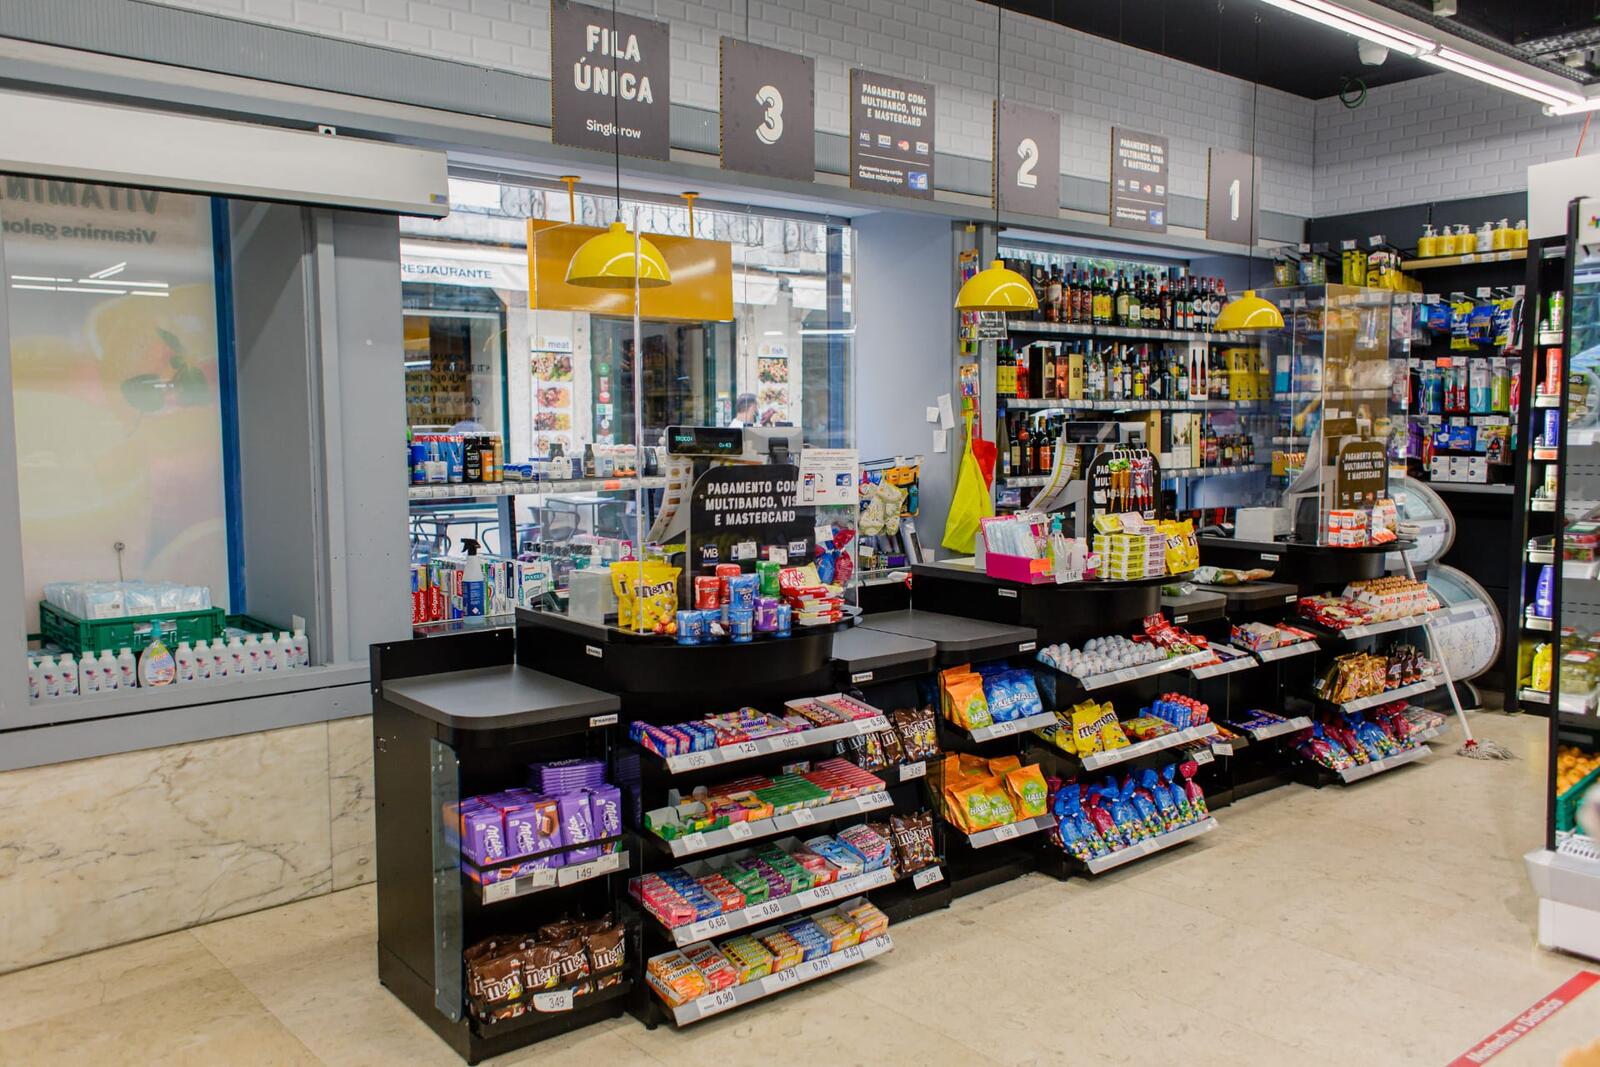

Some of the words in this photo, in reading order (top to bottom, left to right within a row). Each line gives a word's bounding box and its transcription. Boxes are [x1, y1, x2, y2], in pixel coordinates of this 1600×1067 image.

[586, 24, 641, 62] FILA
[574, 56, 653, 104] ÚNICA
[862, 84, 906, 101] PAGAMENTO
[861, 96, 909, 114] MULTIBANCO,
[911, 105, 928, 117] VISA
[755, 85, 784, 144] 3
[867, 108, 872, 118] E
[874, 110, 922, 127] MASTERCARD
[586, 119, 620, 136] Single
[620, 127, 642, 139] row
[1017, 138, 1038, 188] 2
[1229, 179, 1240, 221] 1
[548, 340, 570, 349] meat
[1344, 452, 1371, 460] PAGAMENTO
[1348, 472, 1352, 480] E
[1352, 470, 1381, 480] MASTERCARD
[708, 481, 772, 495] PAGAMENTO
[705, 496, 778, 511] MULTIBANCO,
[714, 514, 721, 526] E
[726, 511, 796, 526] MASTERCARD
[703, 548, 718, 558] MB
[792, 542, 805, 551] VISA
[1014, 692, 1038, 702] HALLS
[1025, 791, 1048, 802] HALLS
[520, 822, 535, 853] Milka
[668, 966, 693, 980] Chiclets
[702, 960, 728, 975] Chiclets
[813, 959, 829, 972] 0,79
[778, 970, 795, 982] 0,79
[716, 991, 734, 1004] 0,90
